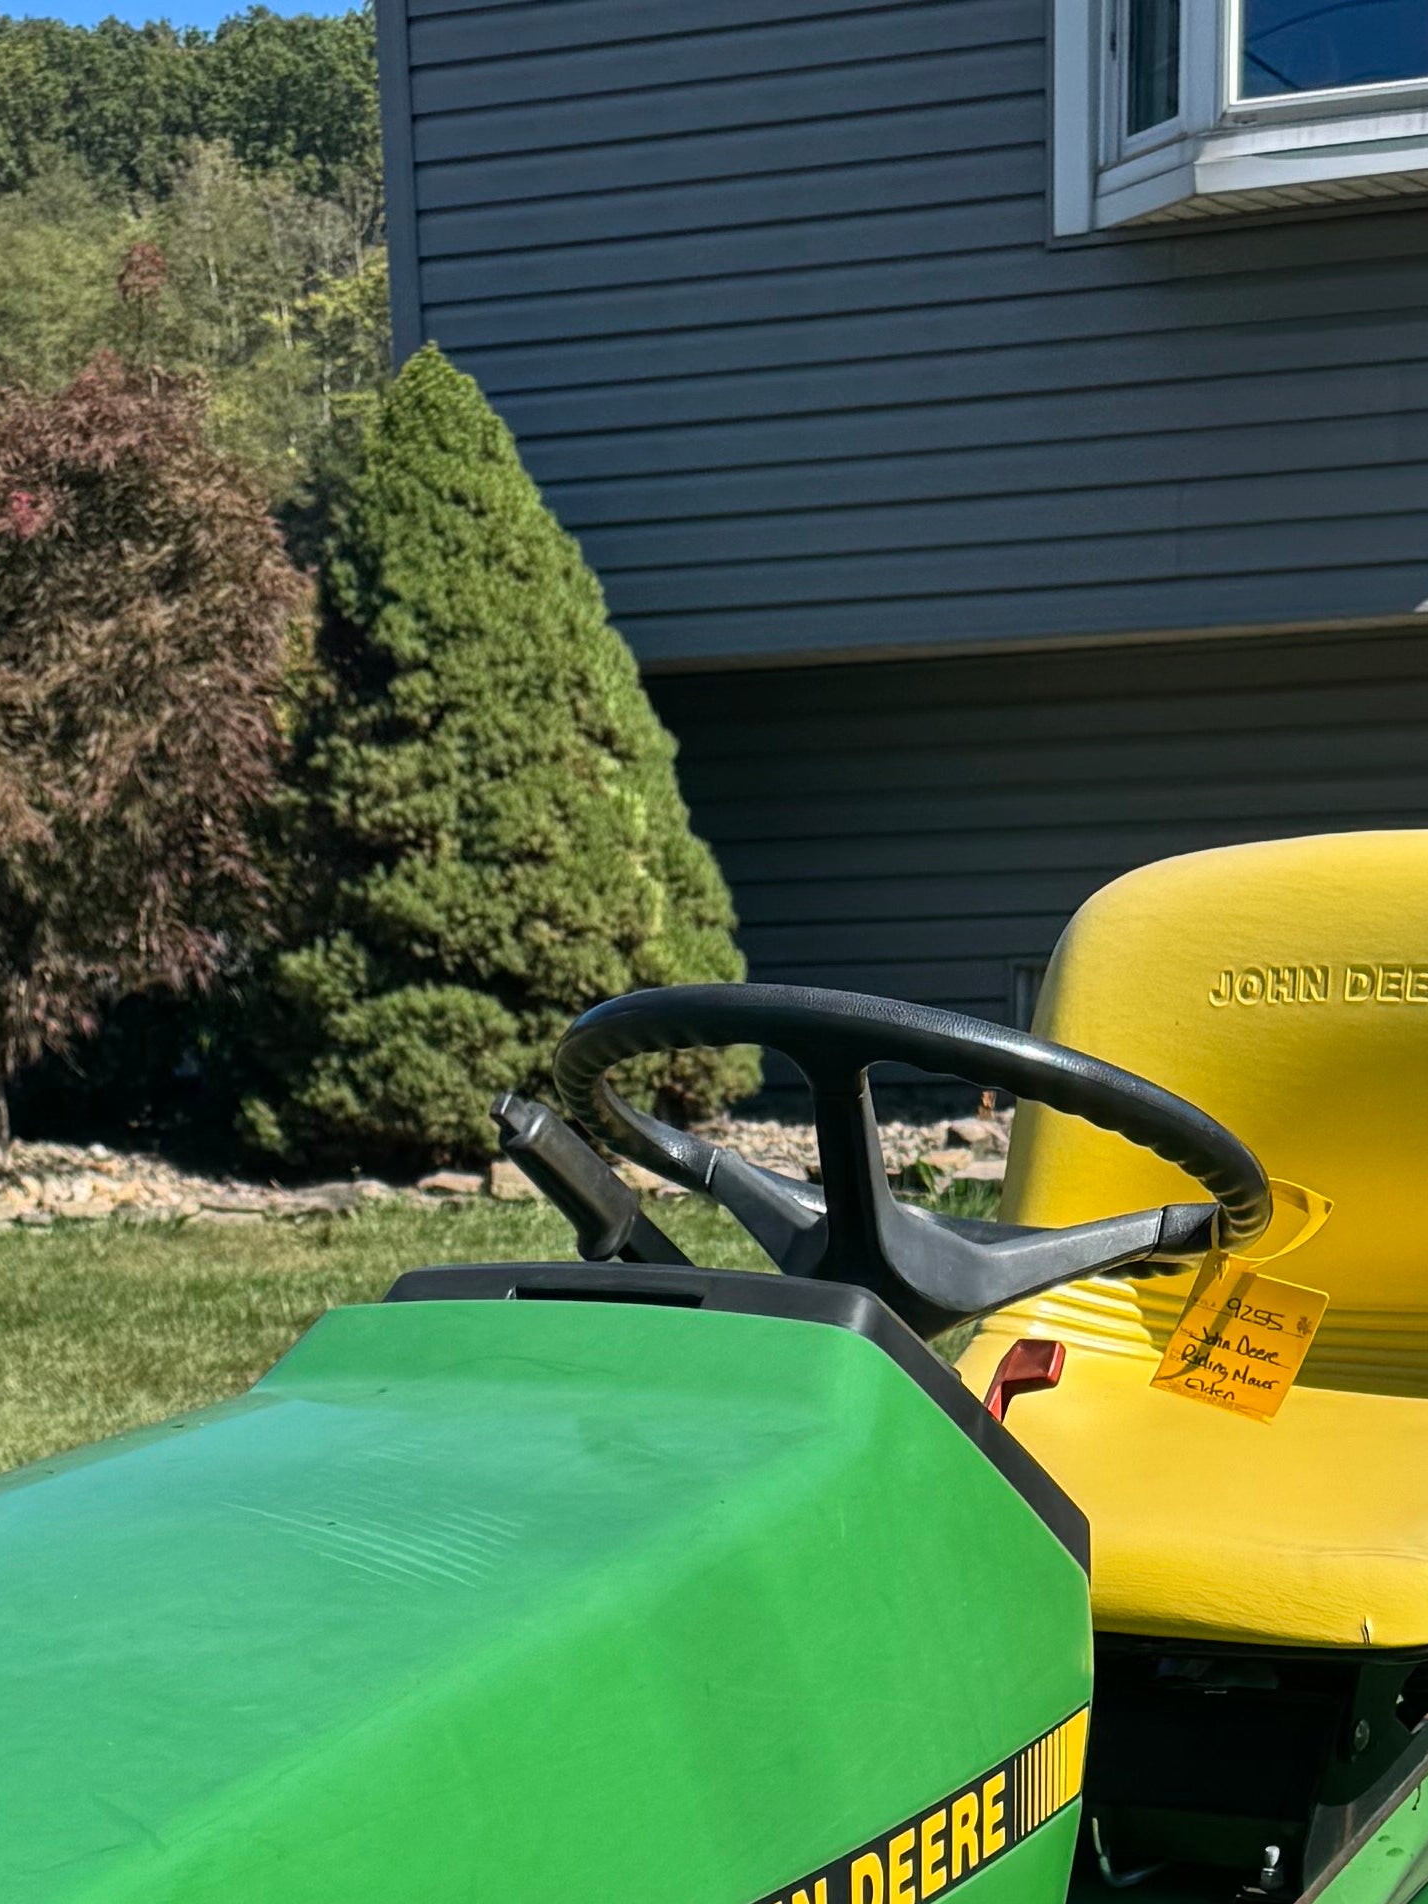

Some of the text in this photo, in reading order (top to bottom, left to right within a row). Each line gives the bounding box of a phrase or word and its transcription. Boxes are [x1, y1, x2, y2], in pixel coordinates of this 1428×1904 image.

[1208, 965, 1330, 1007] JOHN
[1226, 1297, 1285, 1331] 9255
[1181, 1343, 1228, 1384] Riding
[1190, 1326, 1231, 1351] John
[1236, 1335, 1284, 1367] Deere
